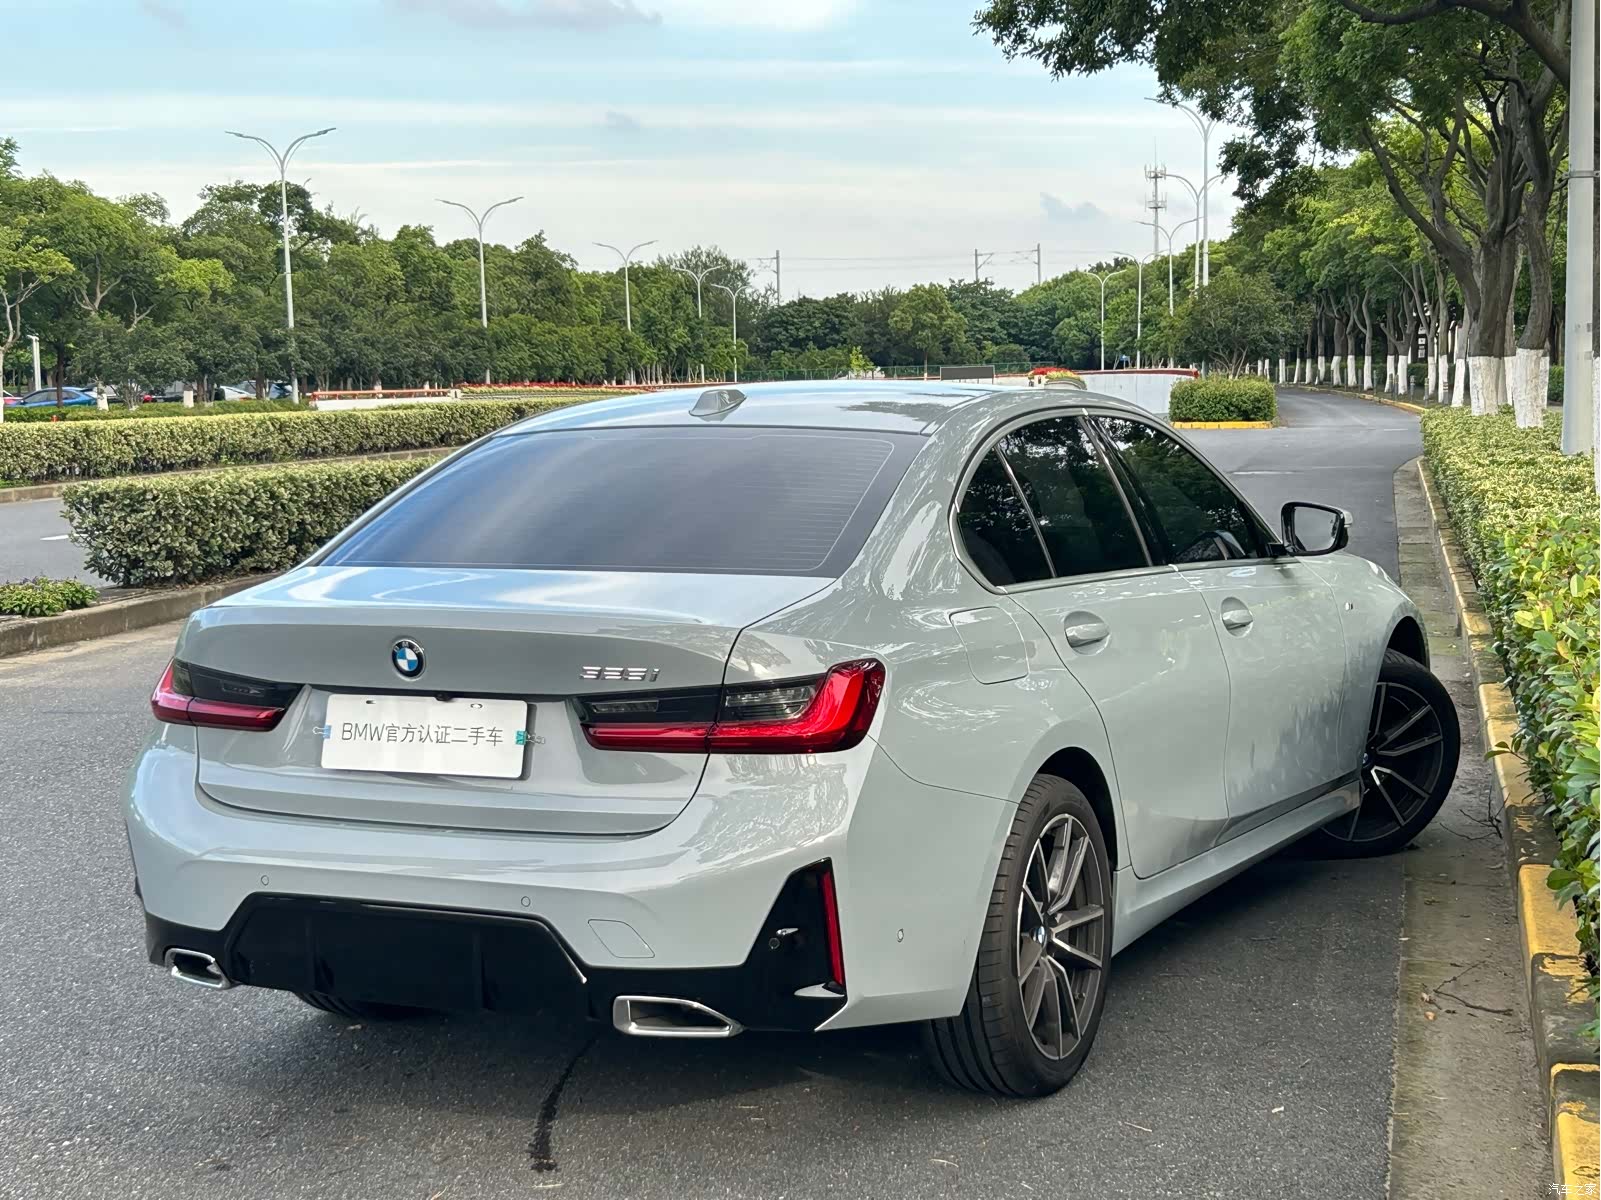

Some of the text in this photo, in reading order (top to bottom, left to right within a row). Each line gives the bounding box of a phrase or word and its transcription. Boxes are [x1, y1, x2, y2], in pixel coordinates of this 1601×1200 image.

[340, 722, 504, 747] BMW官方认证二手车
